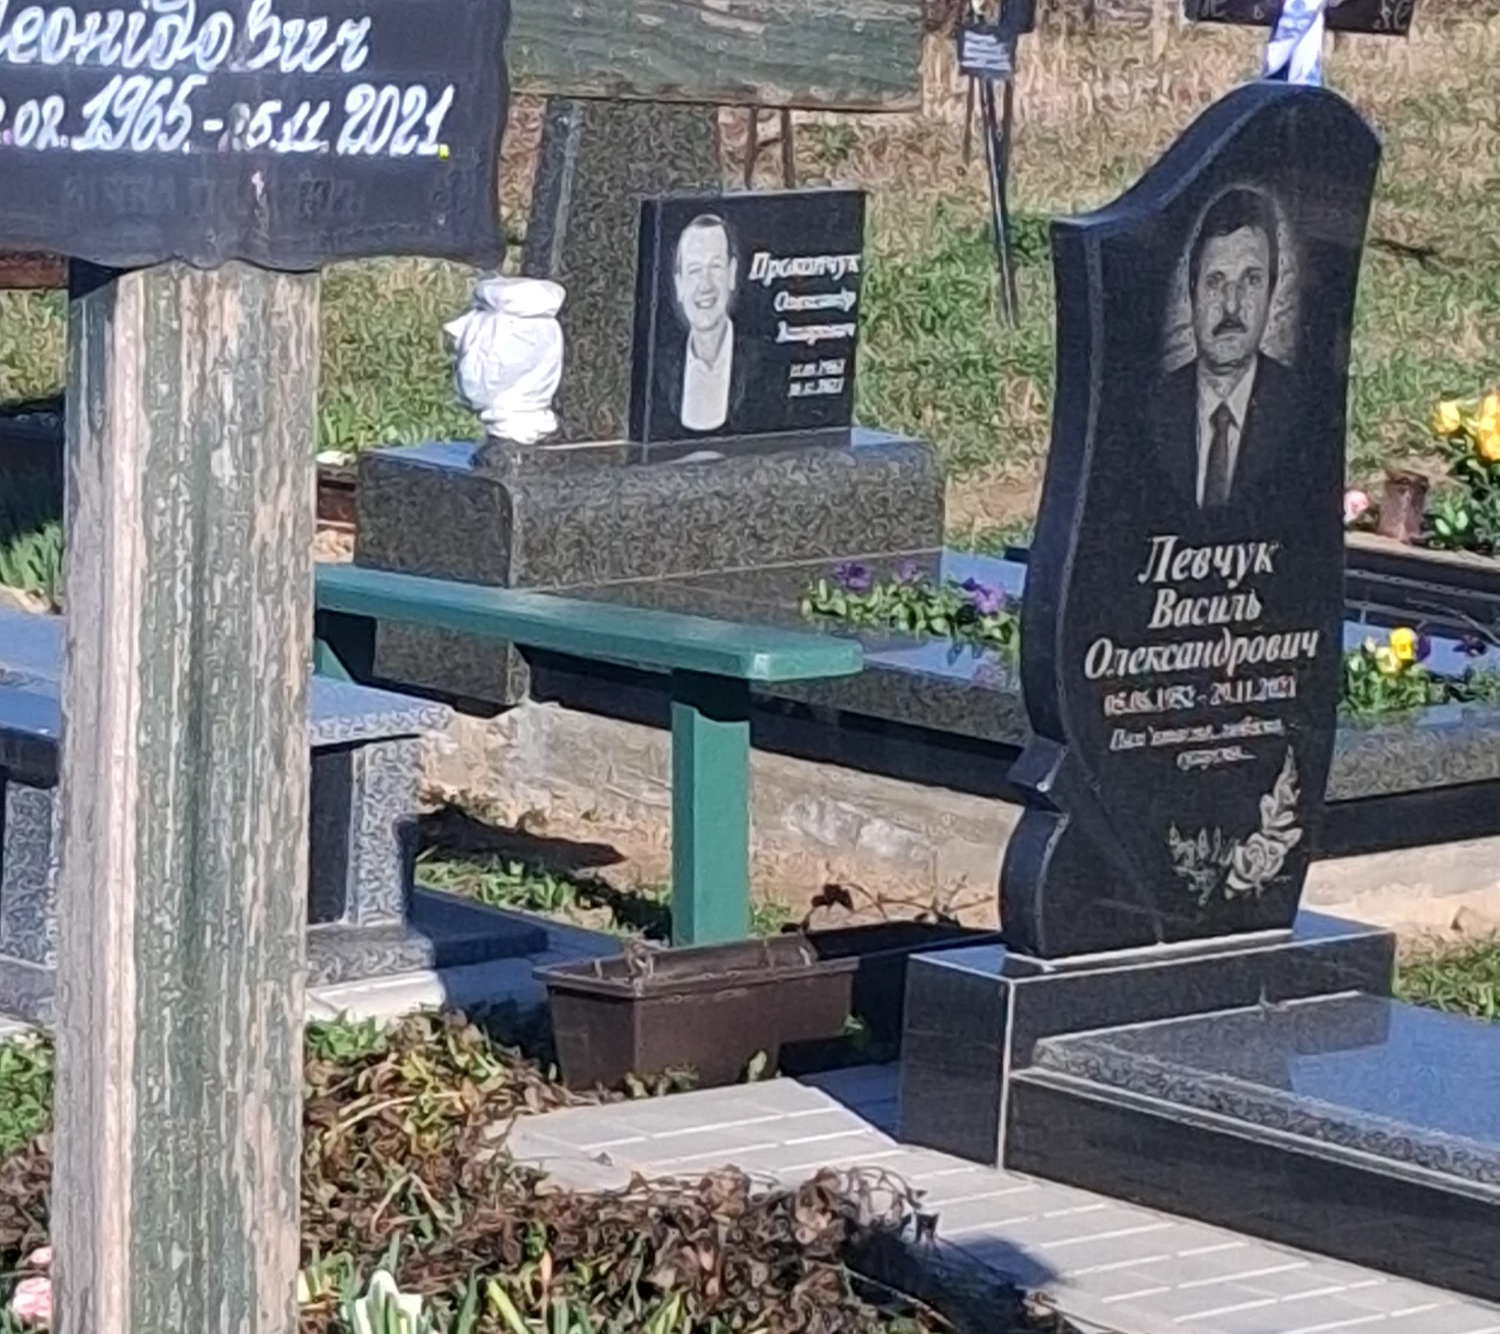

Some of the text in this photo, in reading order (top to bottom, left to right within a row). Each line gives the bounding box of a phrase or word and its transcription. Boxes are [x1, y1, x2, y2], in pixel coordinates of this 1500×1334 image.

[1138, 535, 1279, 588] Левчук
[1148, 588, 1263, 629] Василь
[1085, 627, 1320, 679] Олександрович
